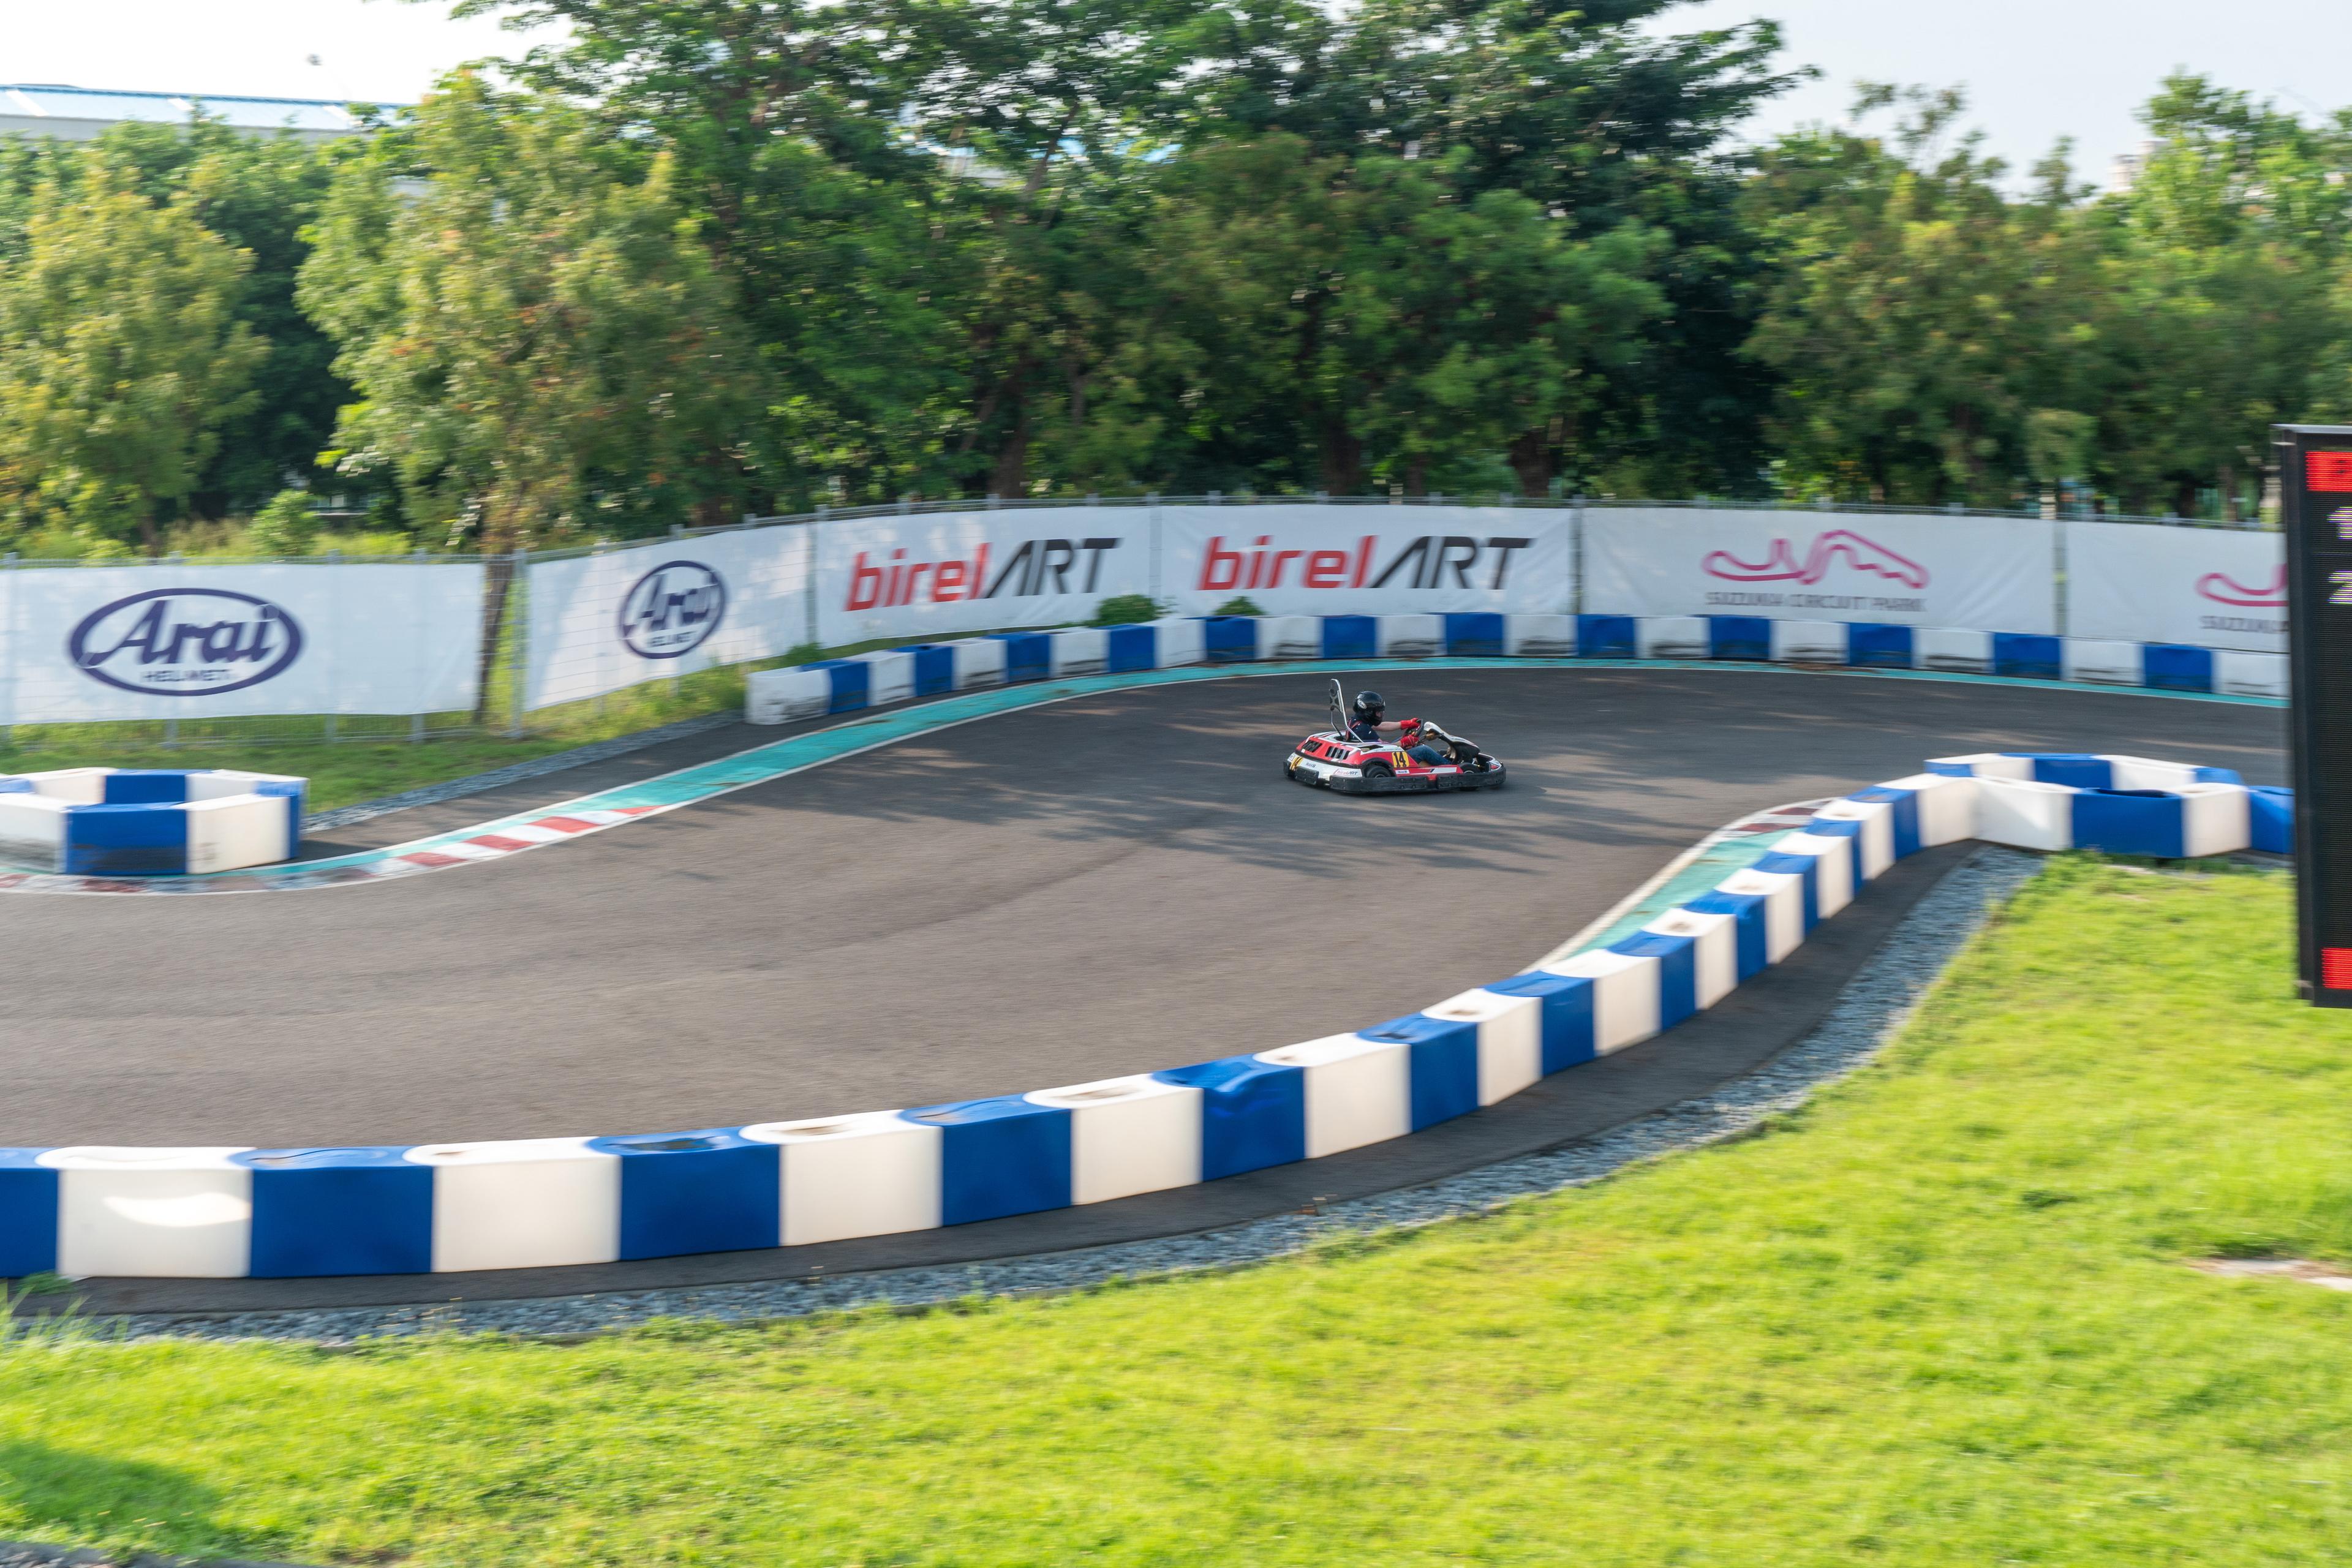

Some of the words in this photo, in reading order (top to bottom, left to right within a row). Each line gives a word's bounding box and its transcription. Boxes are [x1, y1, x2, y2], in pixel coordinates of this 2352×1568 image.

[844, 537, 1123, 612] birelART
[1195, 534, 1536, 590] birelART
[80, 600, 281, 667] Arai
[1393, 752, 1407, 767] 14
